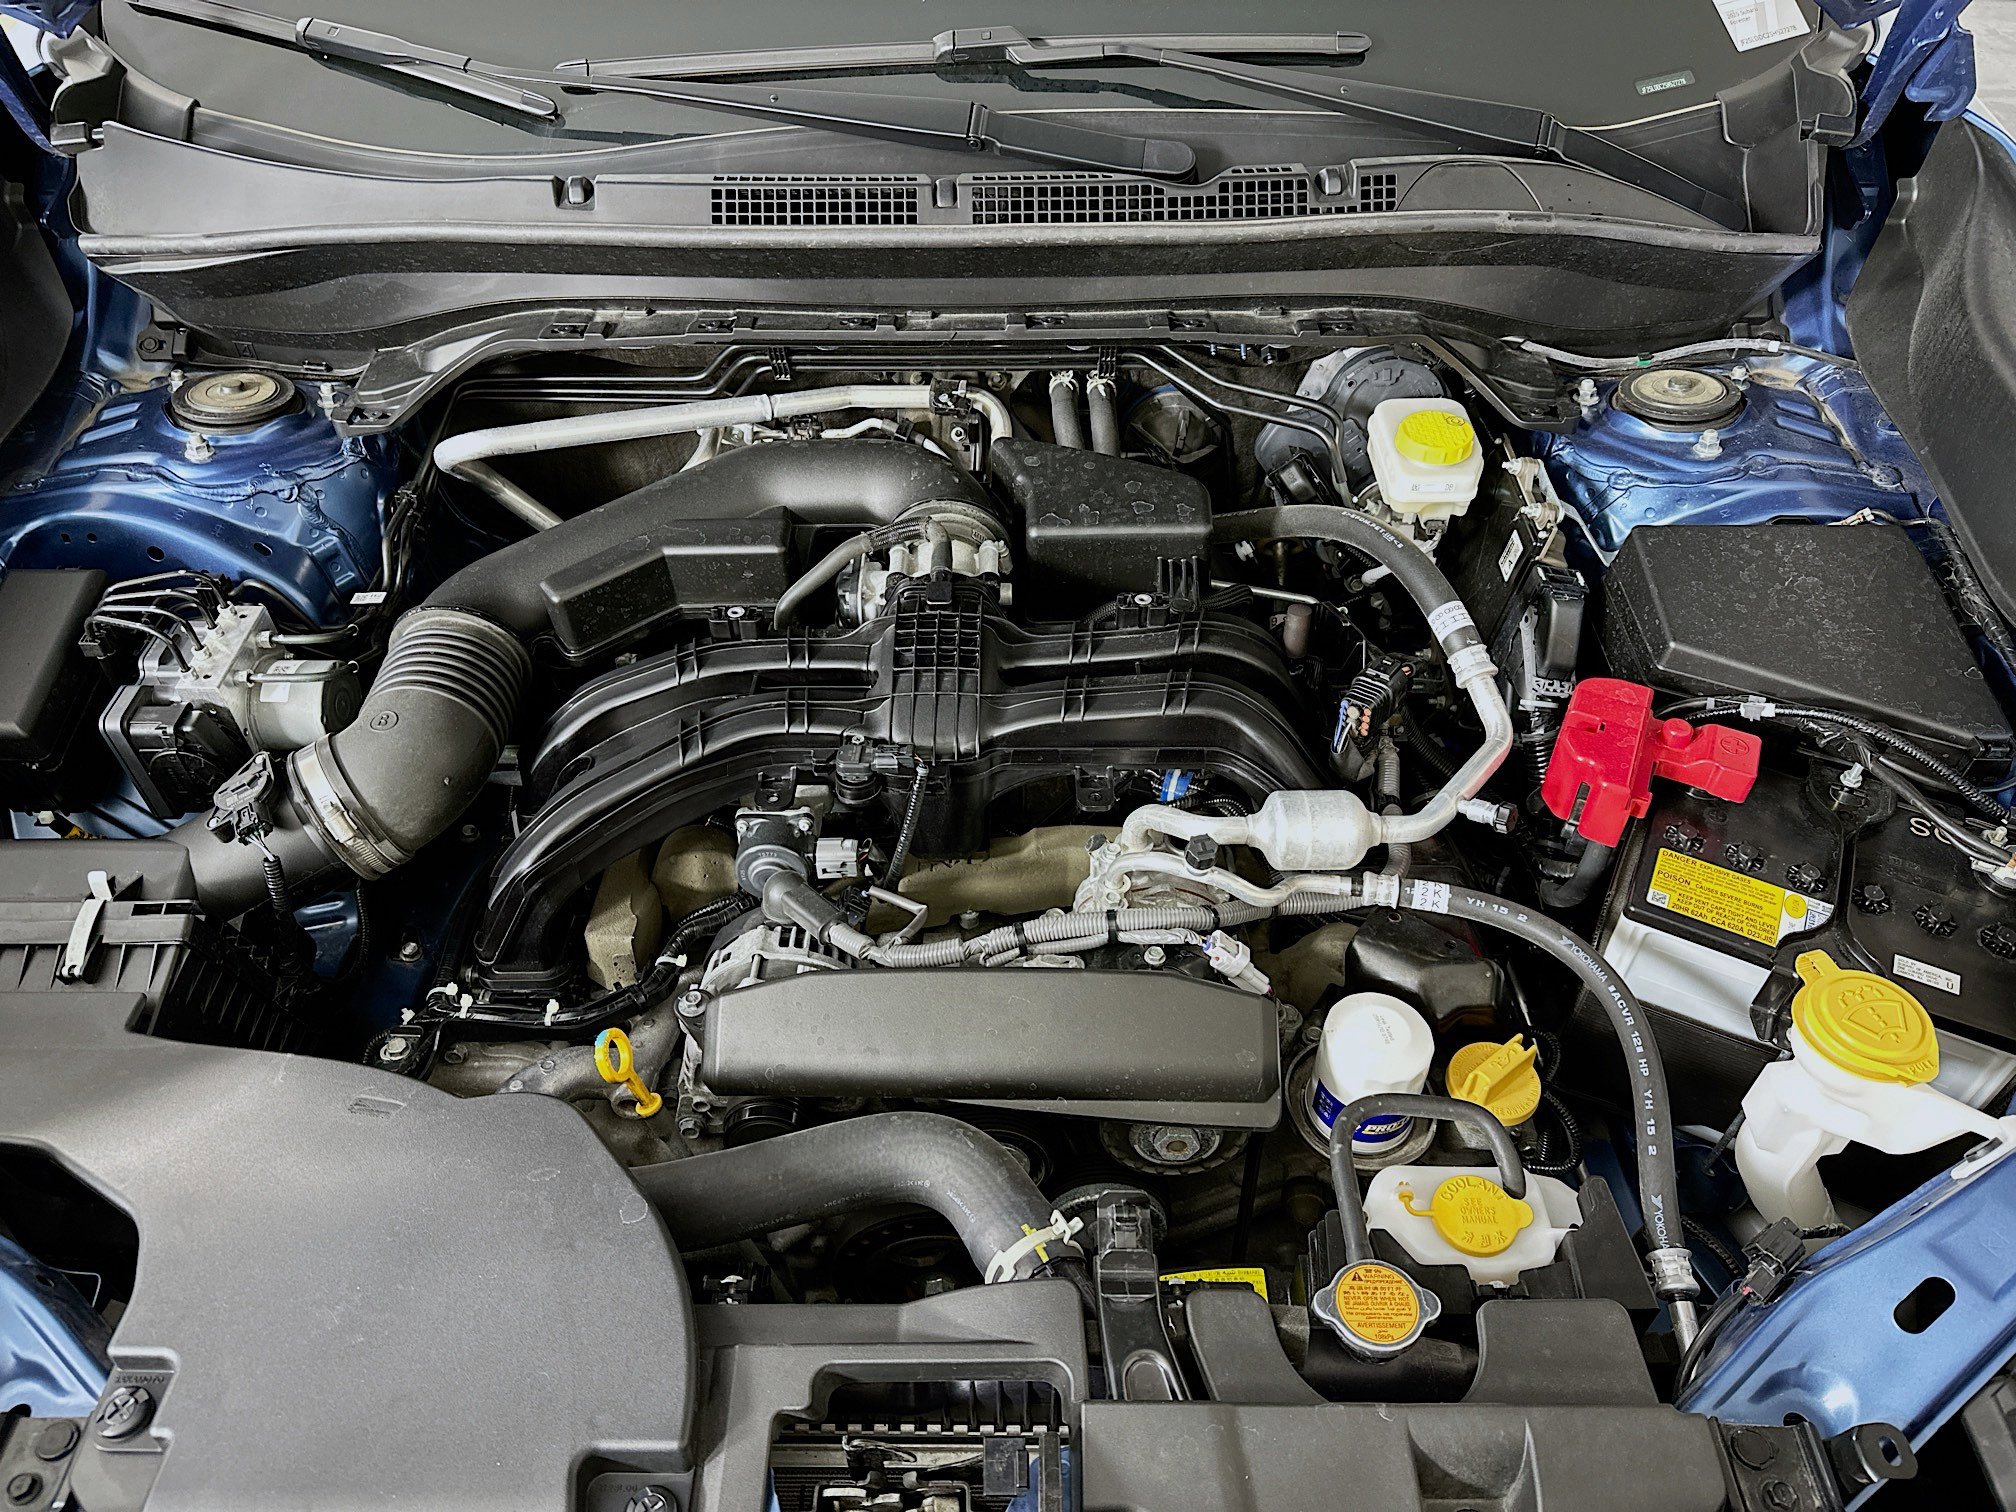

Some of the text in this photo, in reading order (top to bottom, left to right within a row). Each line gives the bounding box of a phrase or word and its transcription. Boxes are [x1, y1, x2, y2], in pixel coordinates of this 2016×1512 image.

[1662, 850, 1751, 884] DANGER EXPLOSIVE GASES
[1434, 889, 1441, 899] K
[1658, 869, 1763, 911] POISON CAUSES SEVERE BURNS
[1466, 896, 1528, 923] YH 15 2
[1672, 902, 1690, 914] 20HR
[1691, 910, 1708, 920] 62Ah
[1711, 916, 1726, 926] CCA
[1727, 922, 1744, 933] 620A
[1677, 898, 1692, 906] KEEP
[1716, 911, 1735, 921] REACH
[1746, 922, 1776, 936] CHILDREN
[1695, 898, 1709, 907] VENT
[1711, 904, 1726, 912] CAPS
[1728, 909, 1744, 919] TIGHT
[1745, 916, 1758, 924] AND
[1759, 921, 1776, 931] LEVEL
[1570, 944, 1608, 983] YOKOHAMA
[1639, 1058, 1650, 1077] HP
[1908, 1060, 1935, 1075] PULL
[1644, 1089, 1653, 1110] YH
[1646, 1118, 1655, 1136] 15
[1648, 1145, 1657, 1156] 2
[1440, 1176, 1508, 1201] COOLANT
[1464, 1198, 1482, 1206] SEE
[1461, 1215, 1498, 1224] MANUAL
